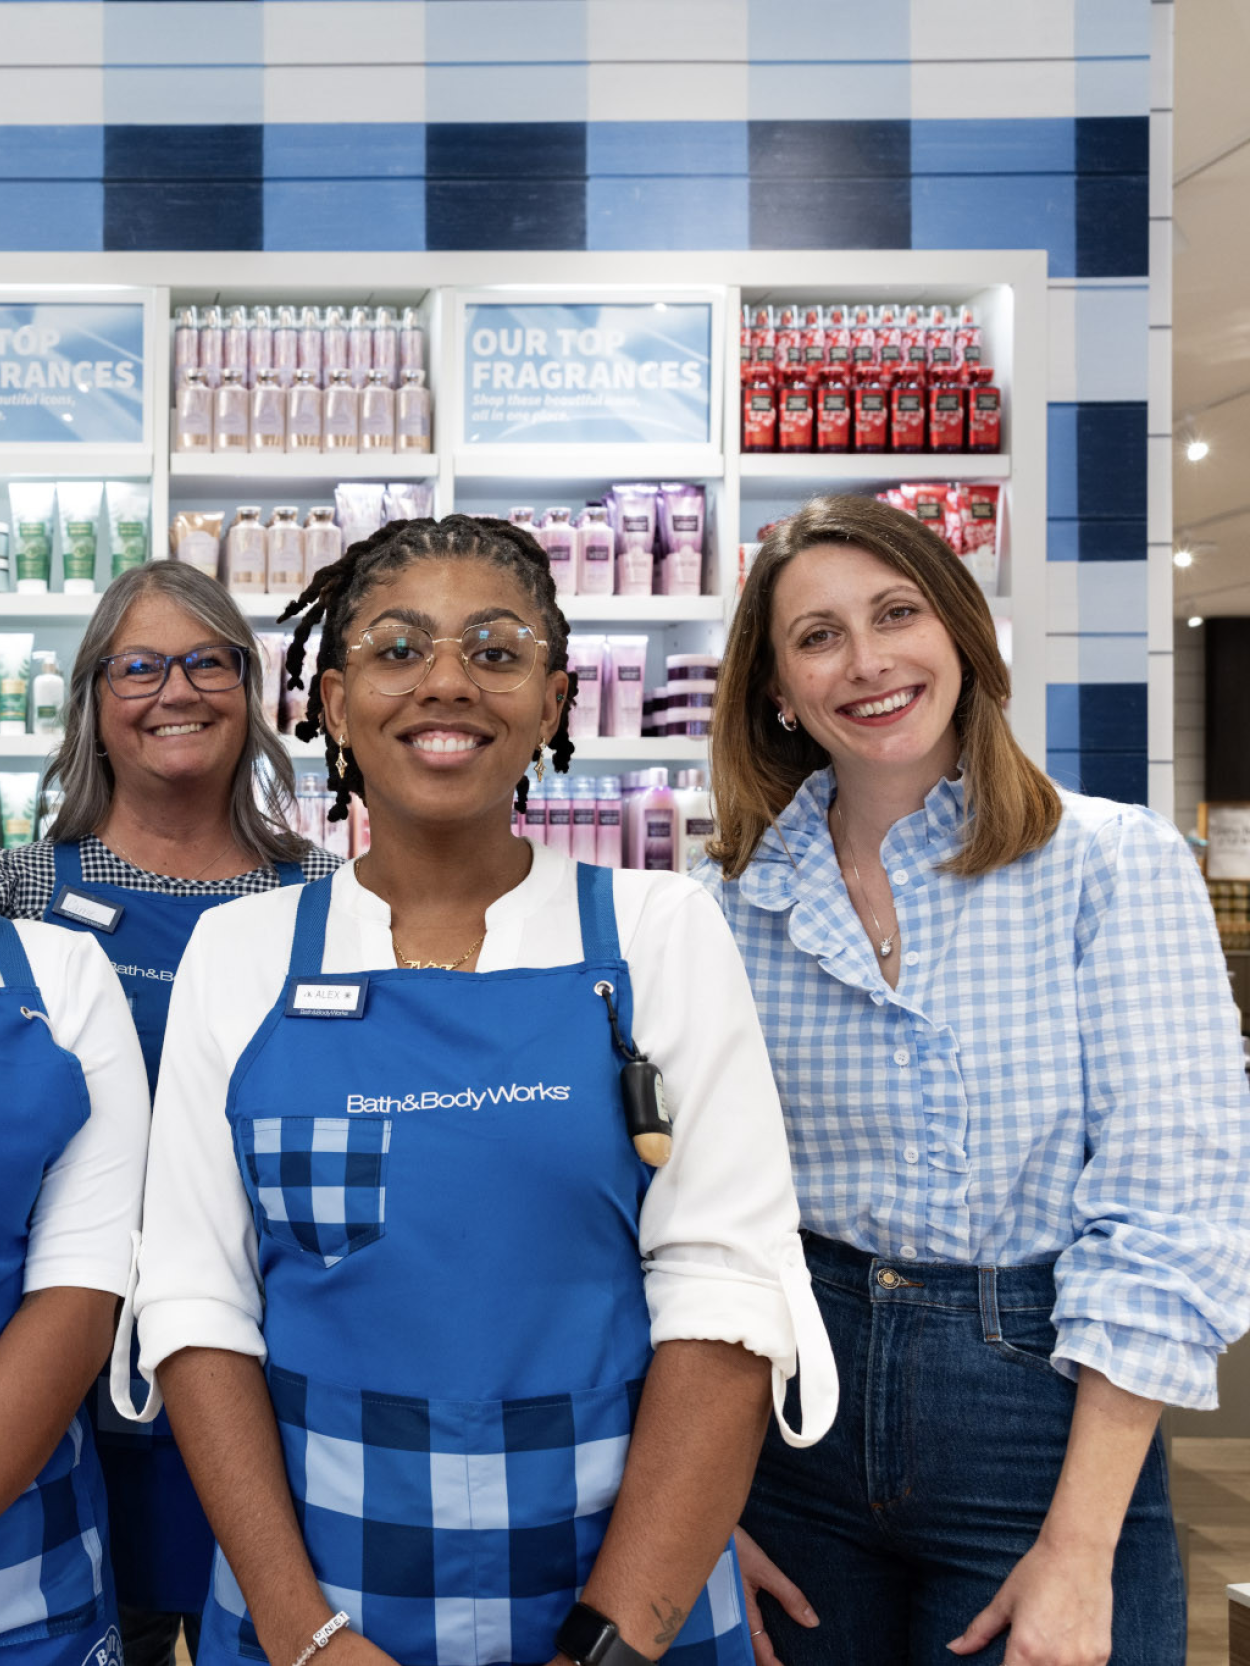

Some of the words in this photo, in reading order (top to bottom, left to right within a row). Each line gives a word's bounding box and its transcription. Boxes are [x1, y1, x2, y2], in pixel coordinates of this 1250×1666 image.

[472, 328, 547, 356] OUR
[556, 328, 626, 356] TOP
[472, 361, 702, 390] FRAGRANCES
[472, 409, 490, 421] all
[491, 409, 504, 421] in
[315, 990, 341, 999] ALEX
[347, 1088, 486, 1113] Bath&Body
